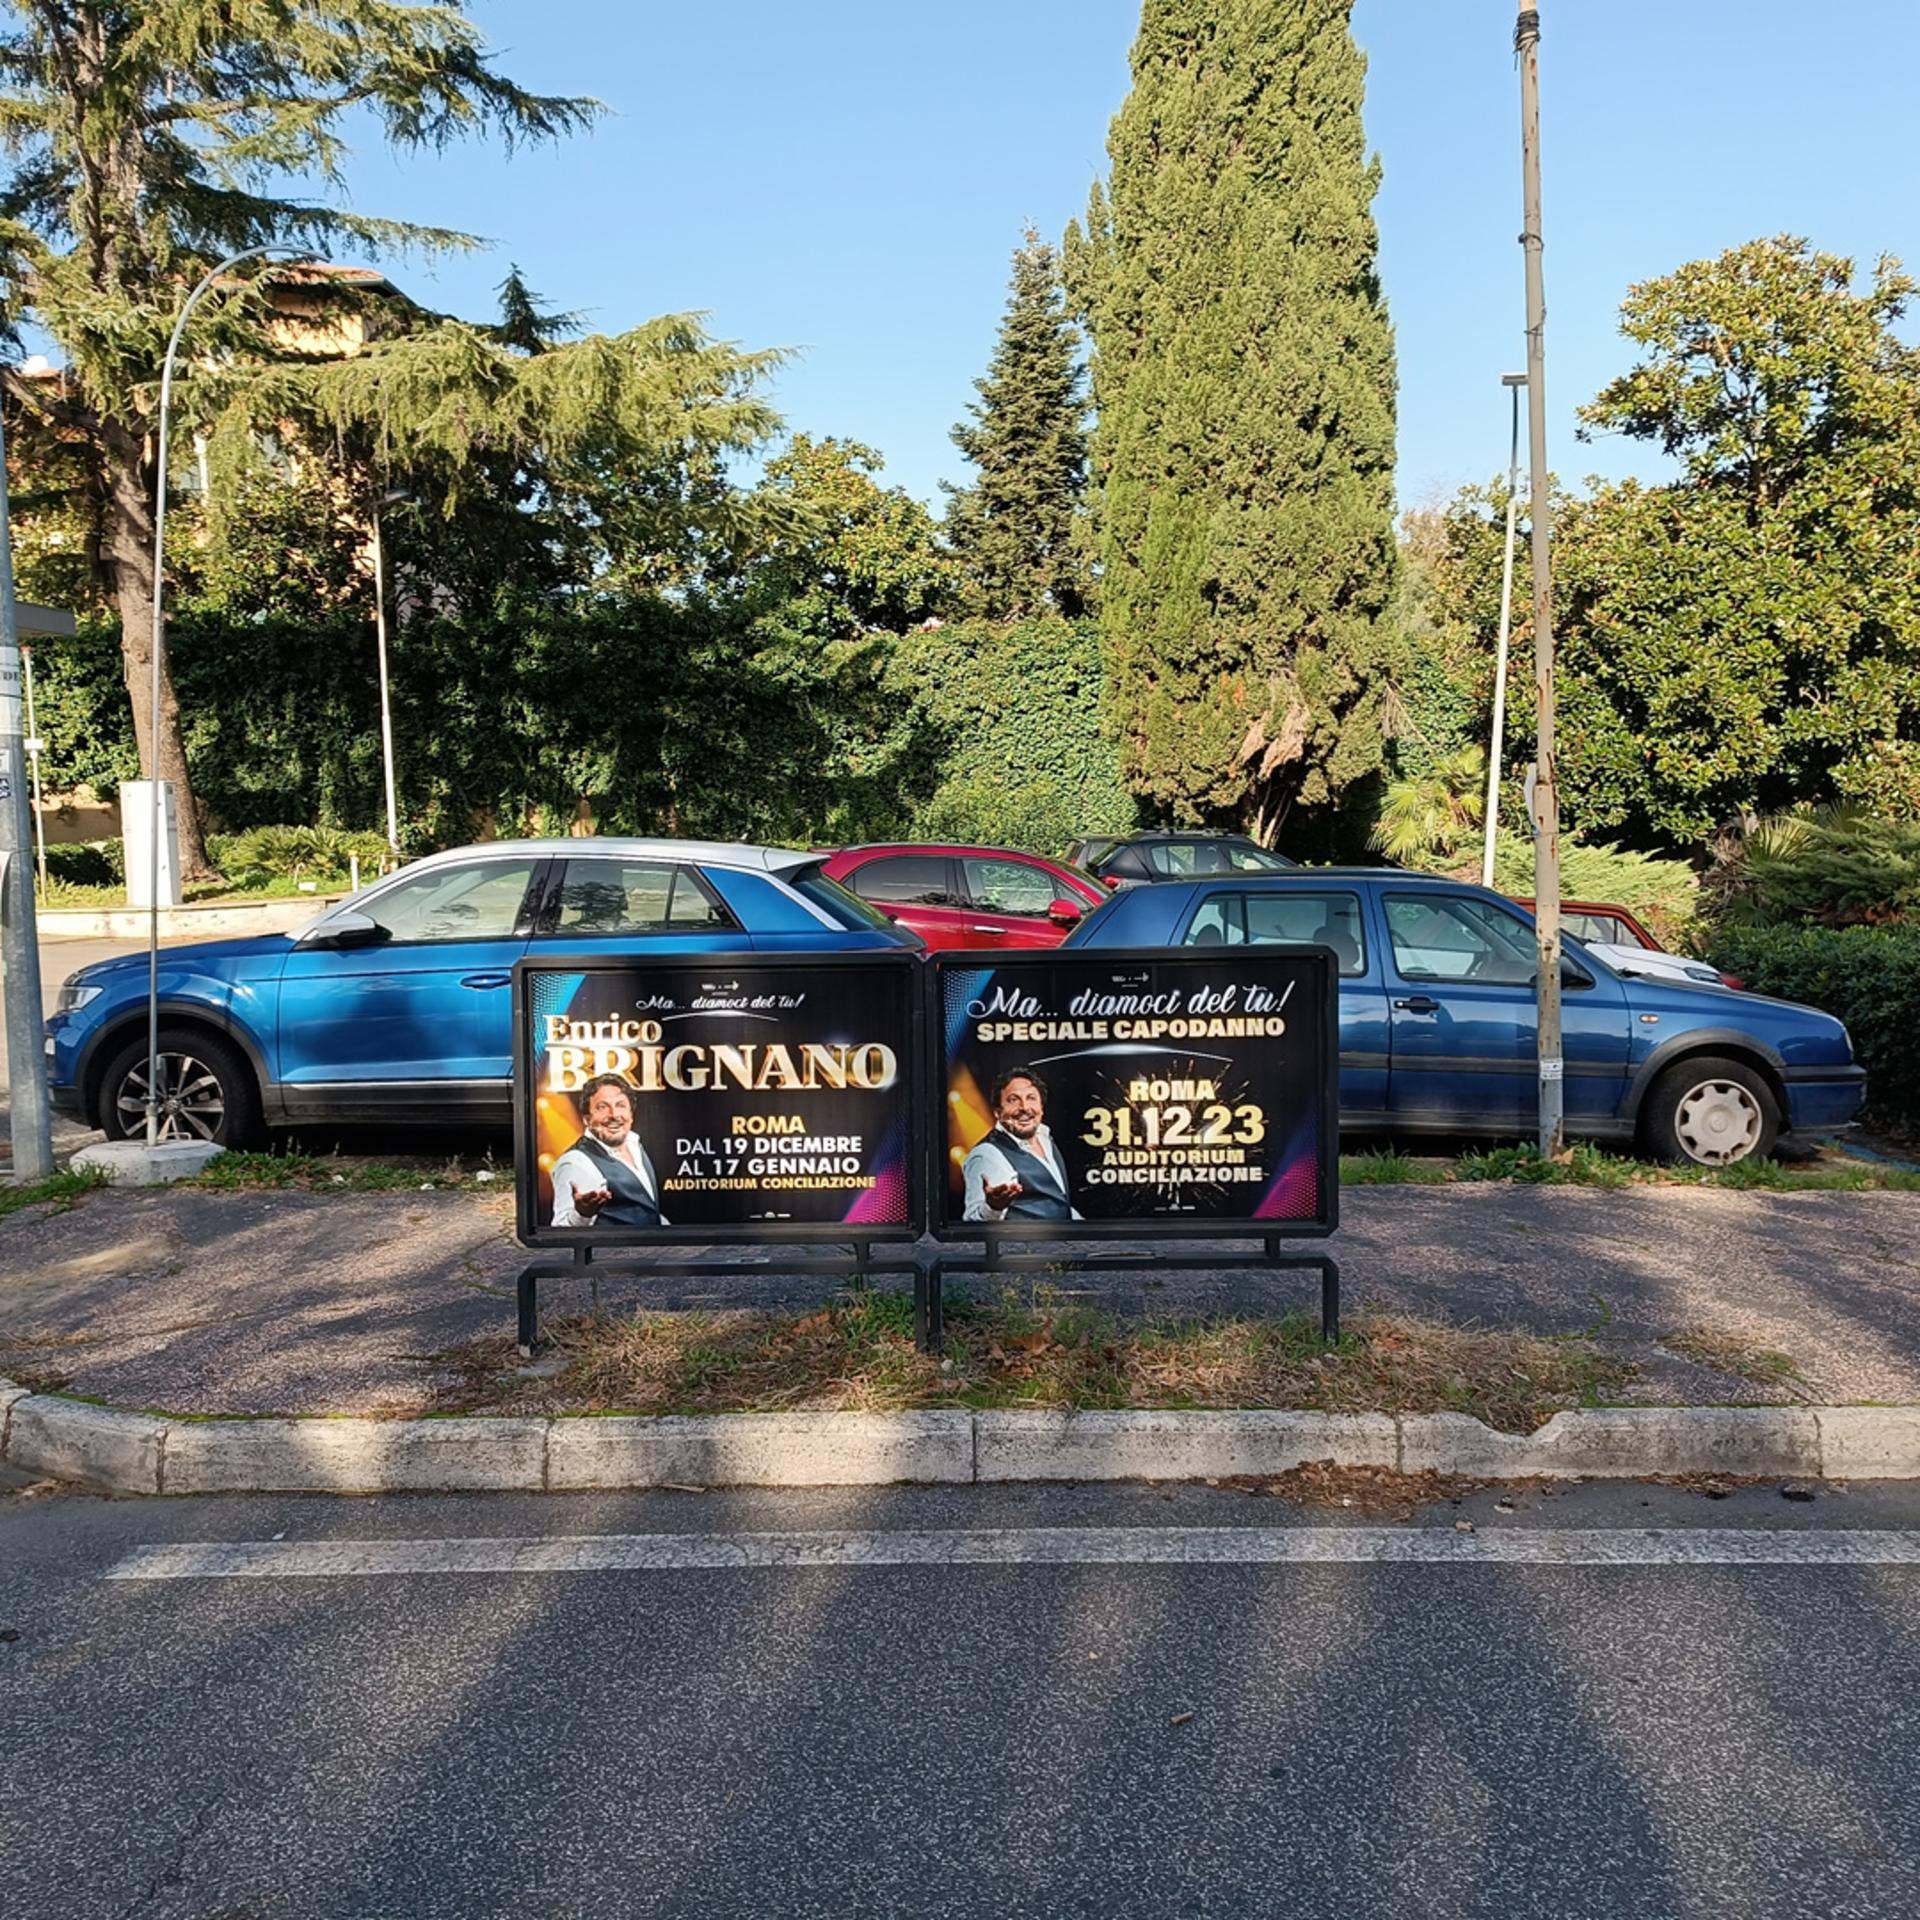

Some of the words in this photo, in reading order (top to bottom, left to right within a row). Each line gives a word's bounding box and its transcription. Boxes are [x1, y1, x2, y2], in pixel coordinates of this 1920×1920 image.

[691, 994, 748, 1009] diamoci
[751, 995, 776, 1009] del
[967, 986, 1058, 1018] Ma...
[1070, 988, 1181, 1016] diamoci
[1188, 984, 1236, 1014] del
[543, 1013, 663, 1044] Enrico
[977, 1020, 1108, 1042] SPECIALE
[1112, 1018, 1285, 1040] CAPODANNO
[546, 1042, 897, 1092] BRIGNANO
[1130, 1080, 1216, 1101] ROMA
[732, 1115, 806, 1135] ROMA
[1083, 1105, 1265, 1146] 31.12.23
[676, 1138, 716, 1155] DAL
[722, 1137, 748, 1155] 19
[755, 1136, 862, 1154] DICEMBRE
[677, 1160, 704, 1176] AL
[713, 1159, 740, 1175] 17
[748, 1157, 860, 1175] GENNAIO
[1103, 1149, 1245, 1165] AUDITORIUM
[664, 1178, 758, 1190] AUDITORIUM
[761, 1176, 876, 1189] CONCILIAZIONE
[1086, 1166, 1263, 1184] CONCILIAZIONE
